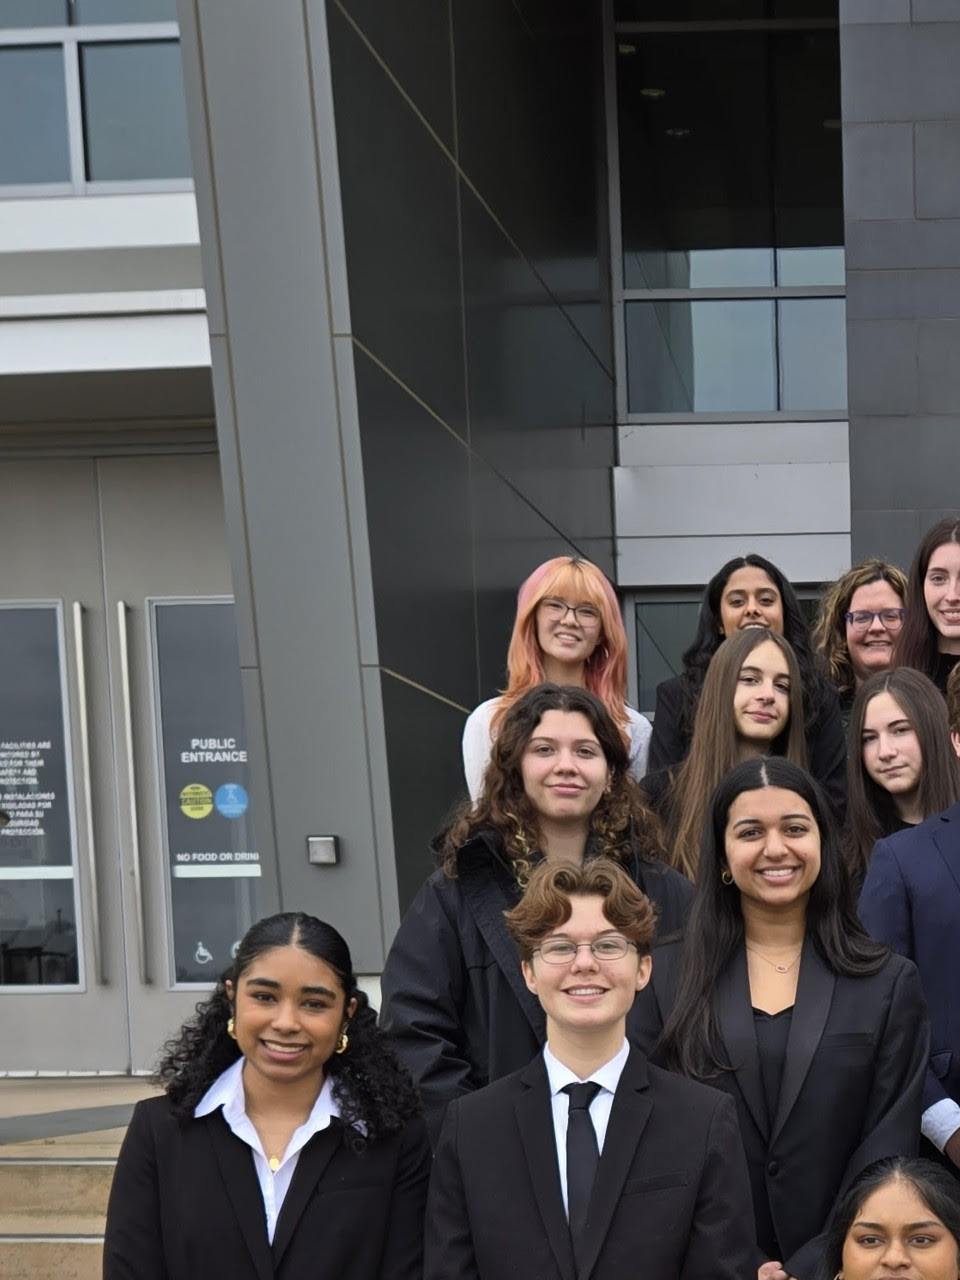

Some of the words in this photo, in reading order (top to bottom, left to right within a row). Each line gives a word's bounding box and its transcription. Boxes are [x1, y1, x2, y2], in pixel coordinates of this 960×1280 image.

[190, 738, 236, 750] PUBLIC
[181, 750, 248, 763] ENTRANCE
[176, 852, 191, 862] NO
[192, 852, 218, 862] FOOD
[219, 852, 233, 862] OR
